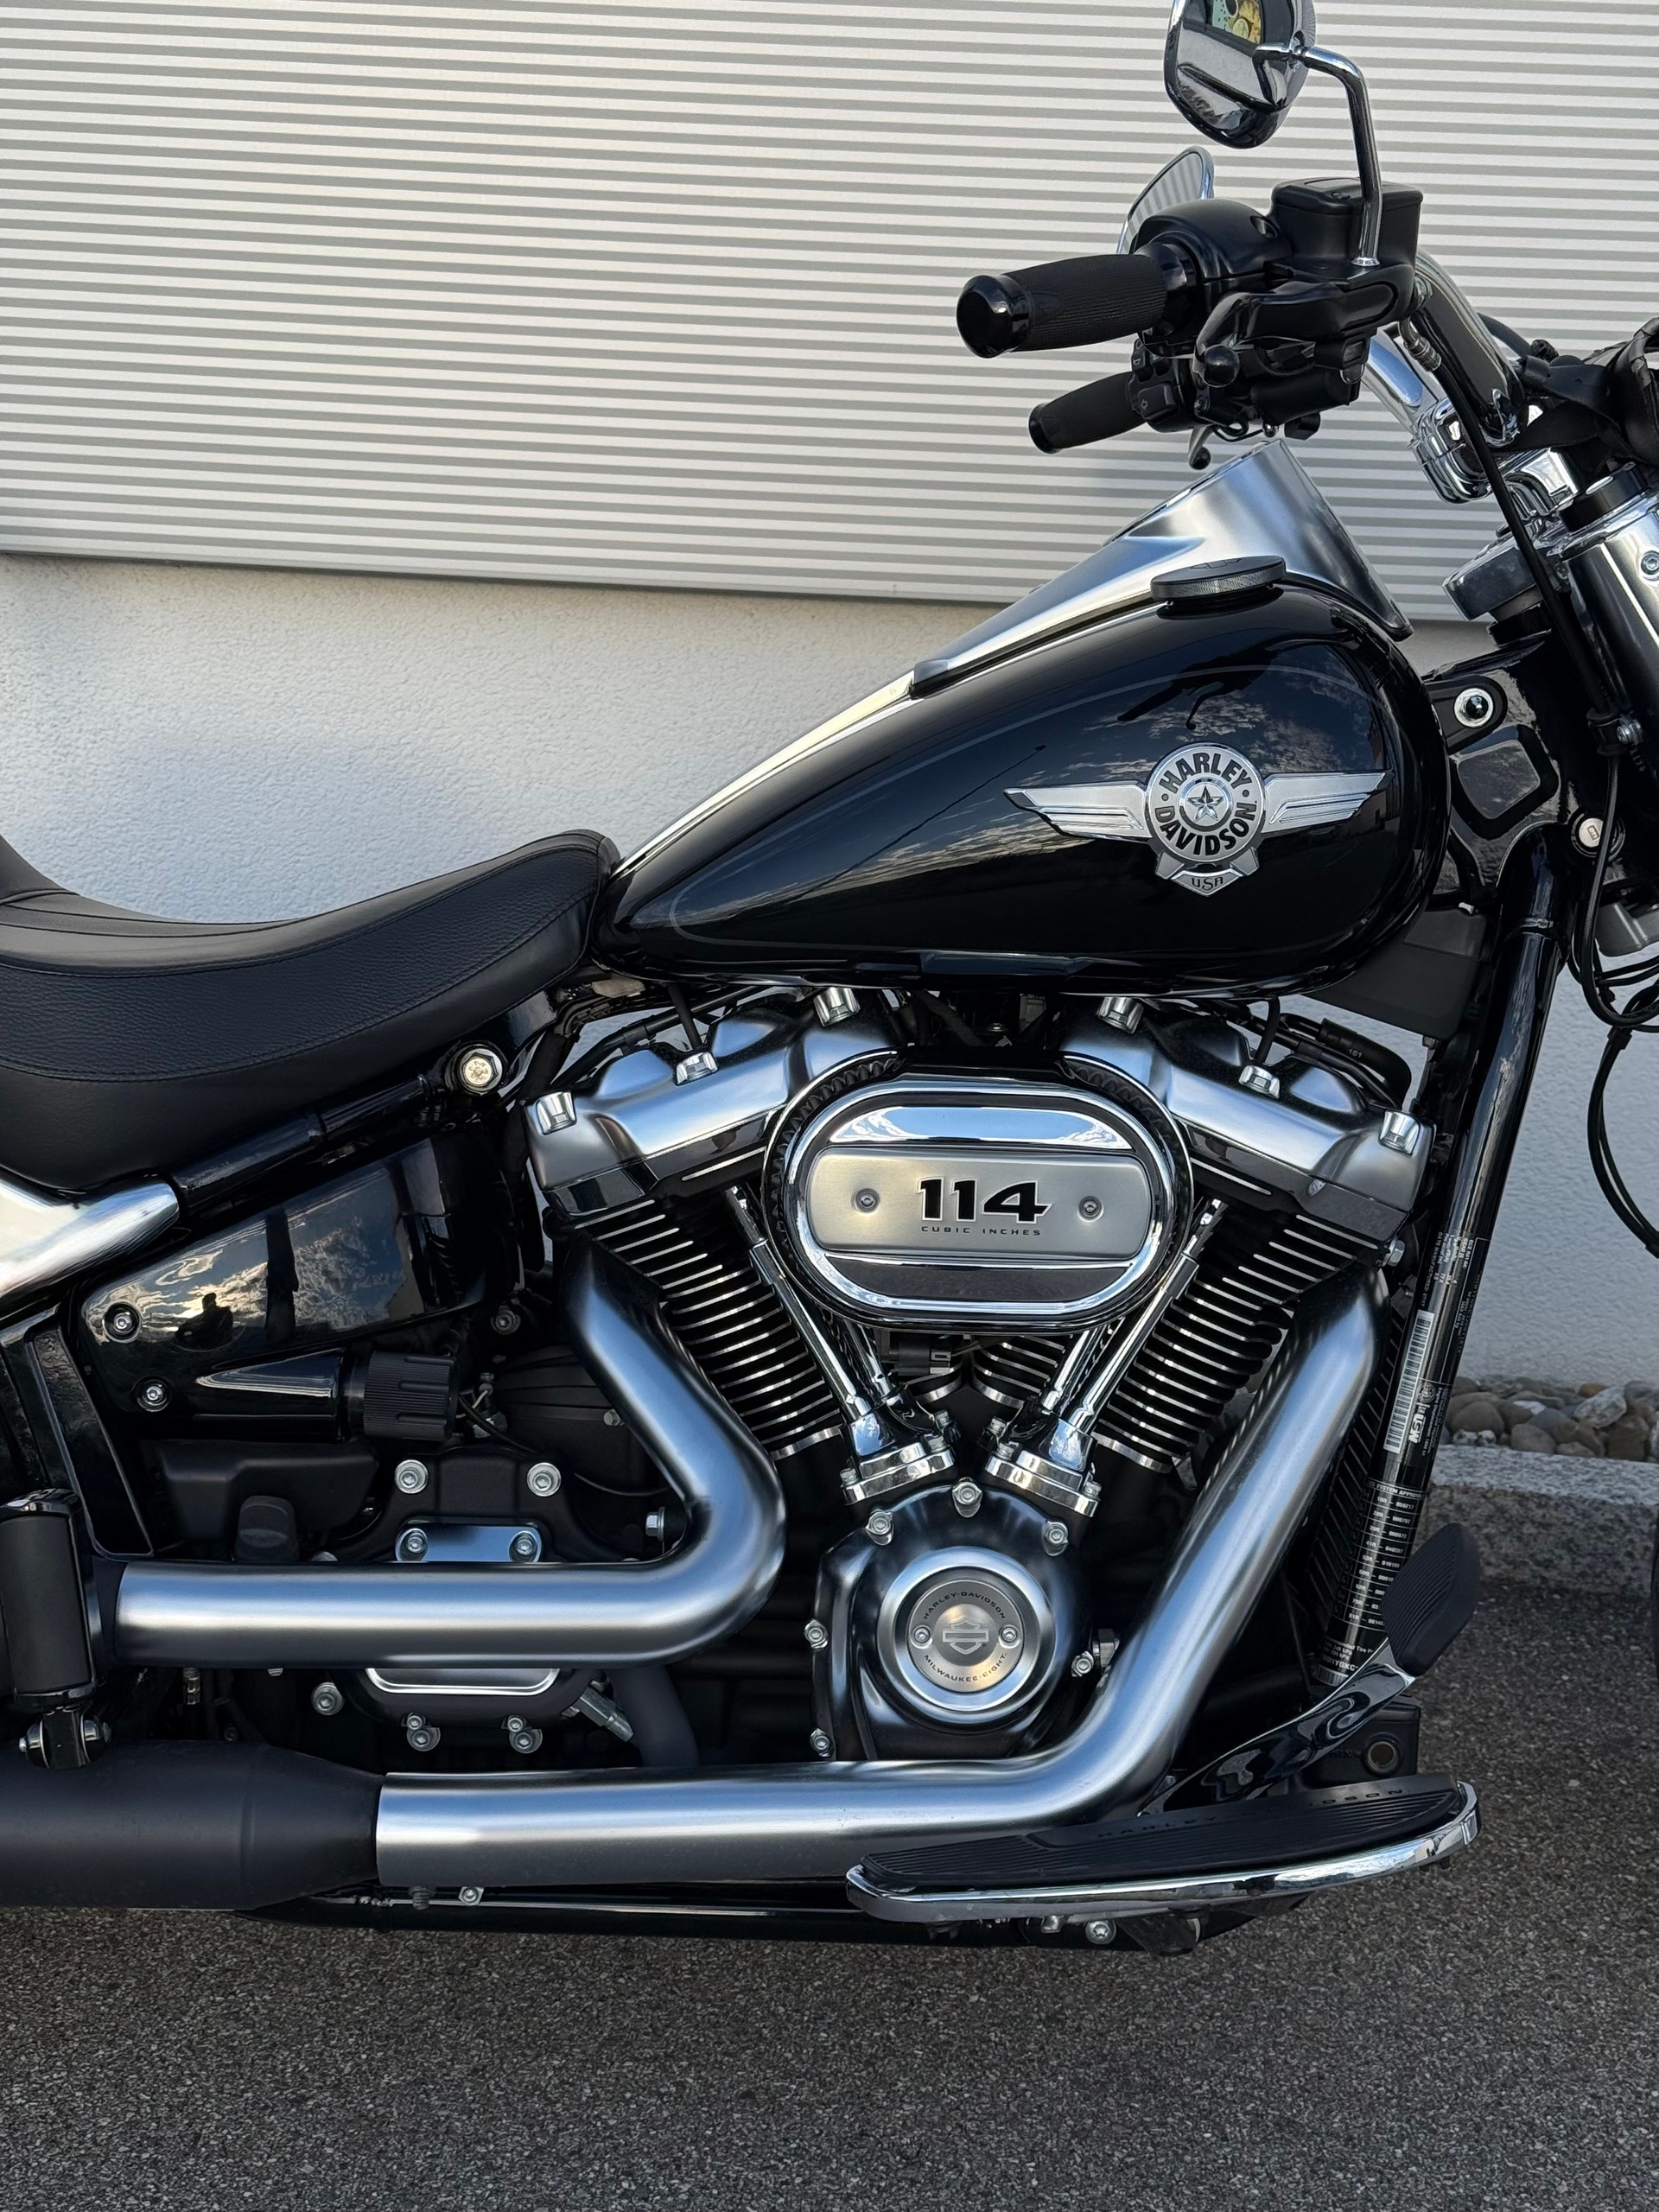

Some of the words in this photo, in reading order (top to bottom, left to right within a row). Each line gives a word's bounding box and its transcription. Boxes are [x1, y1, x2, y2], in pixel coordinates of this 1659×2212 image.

[1159, 752, 1252, 793] HARLEY
[1154, 802, 1257, 856] DAVIDSON
[1191, 876, 1224, 891] USA
[917, 1176, 1053, 1224] 114
[982, 1228, 1040, 1236] INCHES
[1376, 1484, 1398, 1493] SYSTEM
[924, 1591, 1006, 1620] HARLEY-DAVIDSON
[924, 1652, 1007, 1682] MILWAUKEE-EIGHT
